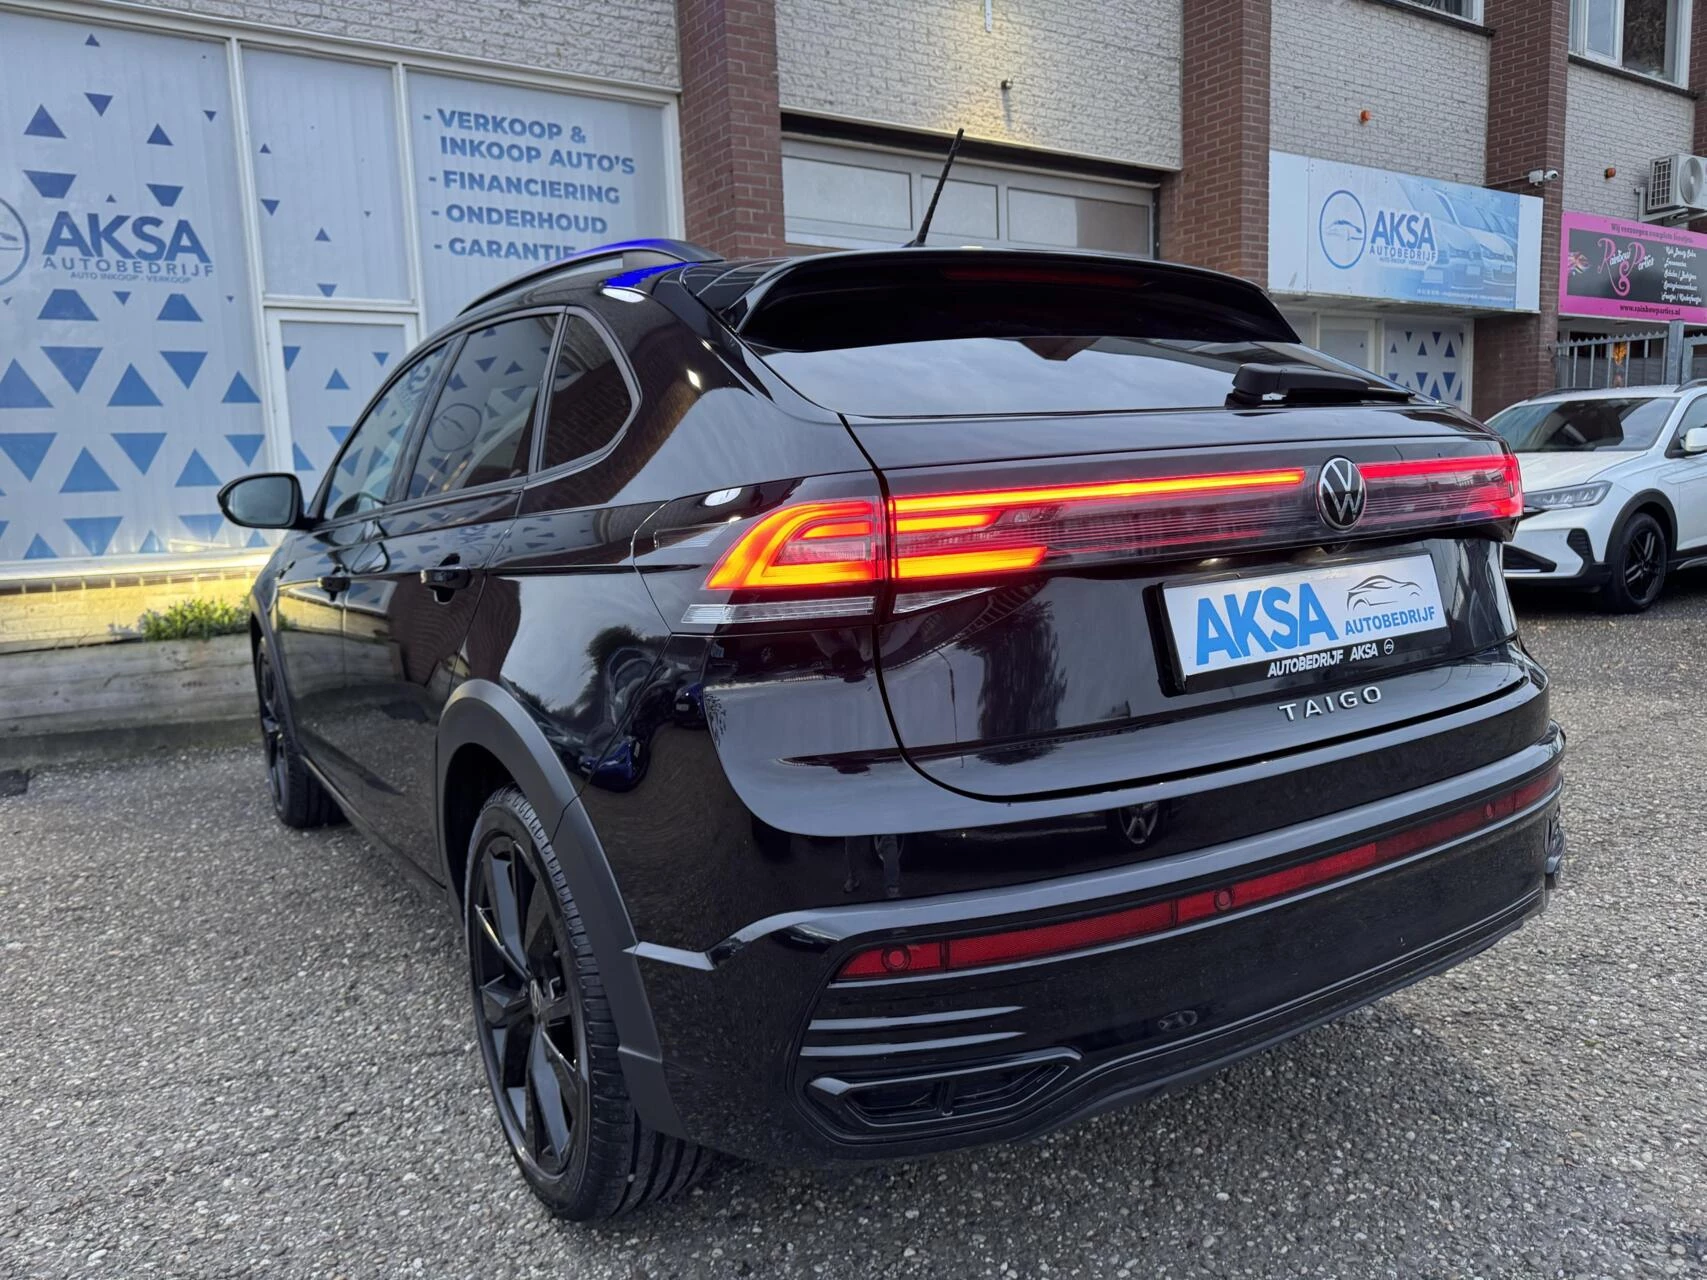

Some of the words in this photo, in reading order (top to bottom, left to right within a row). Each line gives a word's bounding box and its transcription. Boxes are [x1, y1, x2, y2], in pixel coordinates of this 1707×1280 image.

[437, 108, 562, 140] VERKOOP
[570, 126, 586, 144] &
[440, 136, 541, 163] INKOOP
[549, 149, 635, 175] AUTO'S
[443, 170, 619, 204] FINANCIERING
[446, 204, 607, 234] ONDERHOUD
[1370, 210, 1436, 251] AKSA
[42, 211, 211, 263] AKSA
[1369, 245, 1436, 262] AUTOBEDRIJF
[43, 255, 214, 277] AUTOBEDRIJF
[70, 272, 97, 280] AUTO
[1196, 583, 1339, 665] AKSA
[1345, 606, 1436, 636] AUTOBEDRIJF
[1267, 649, 1344, 678] AUTOBEDRIJF
[1350, 642, 1378, 662] AKSA
[1278, 686, 1382, 721] TAIGO
